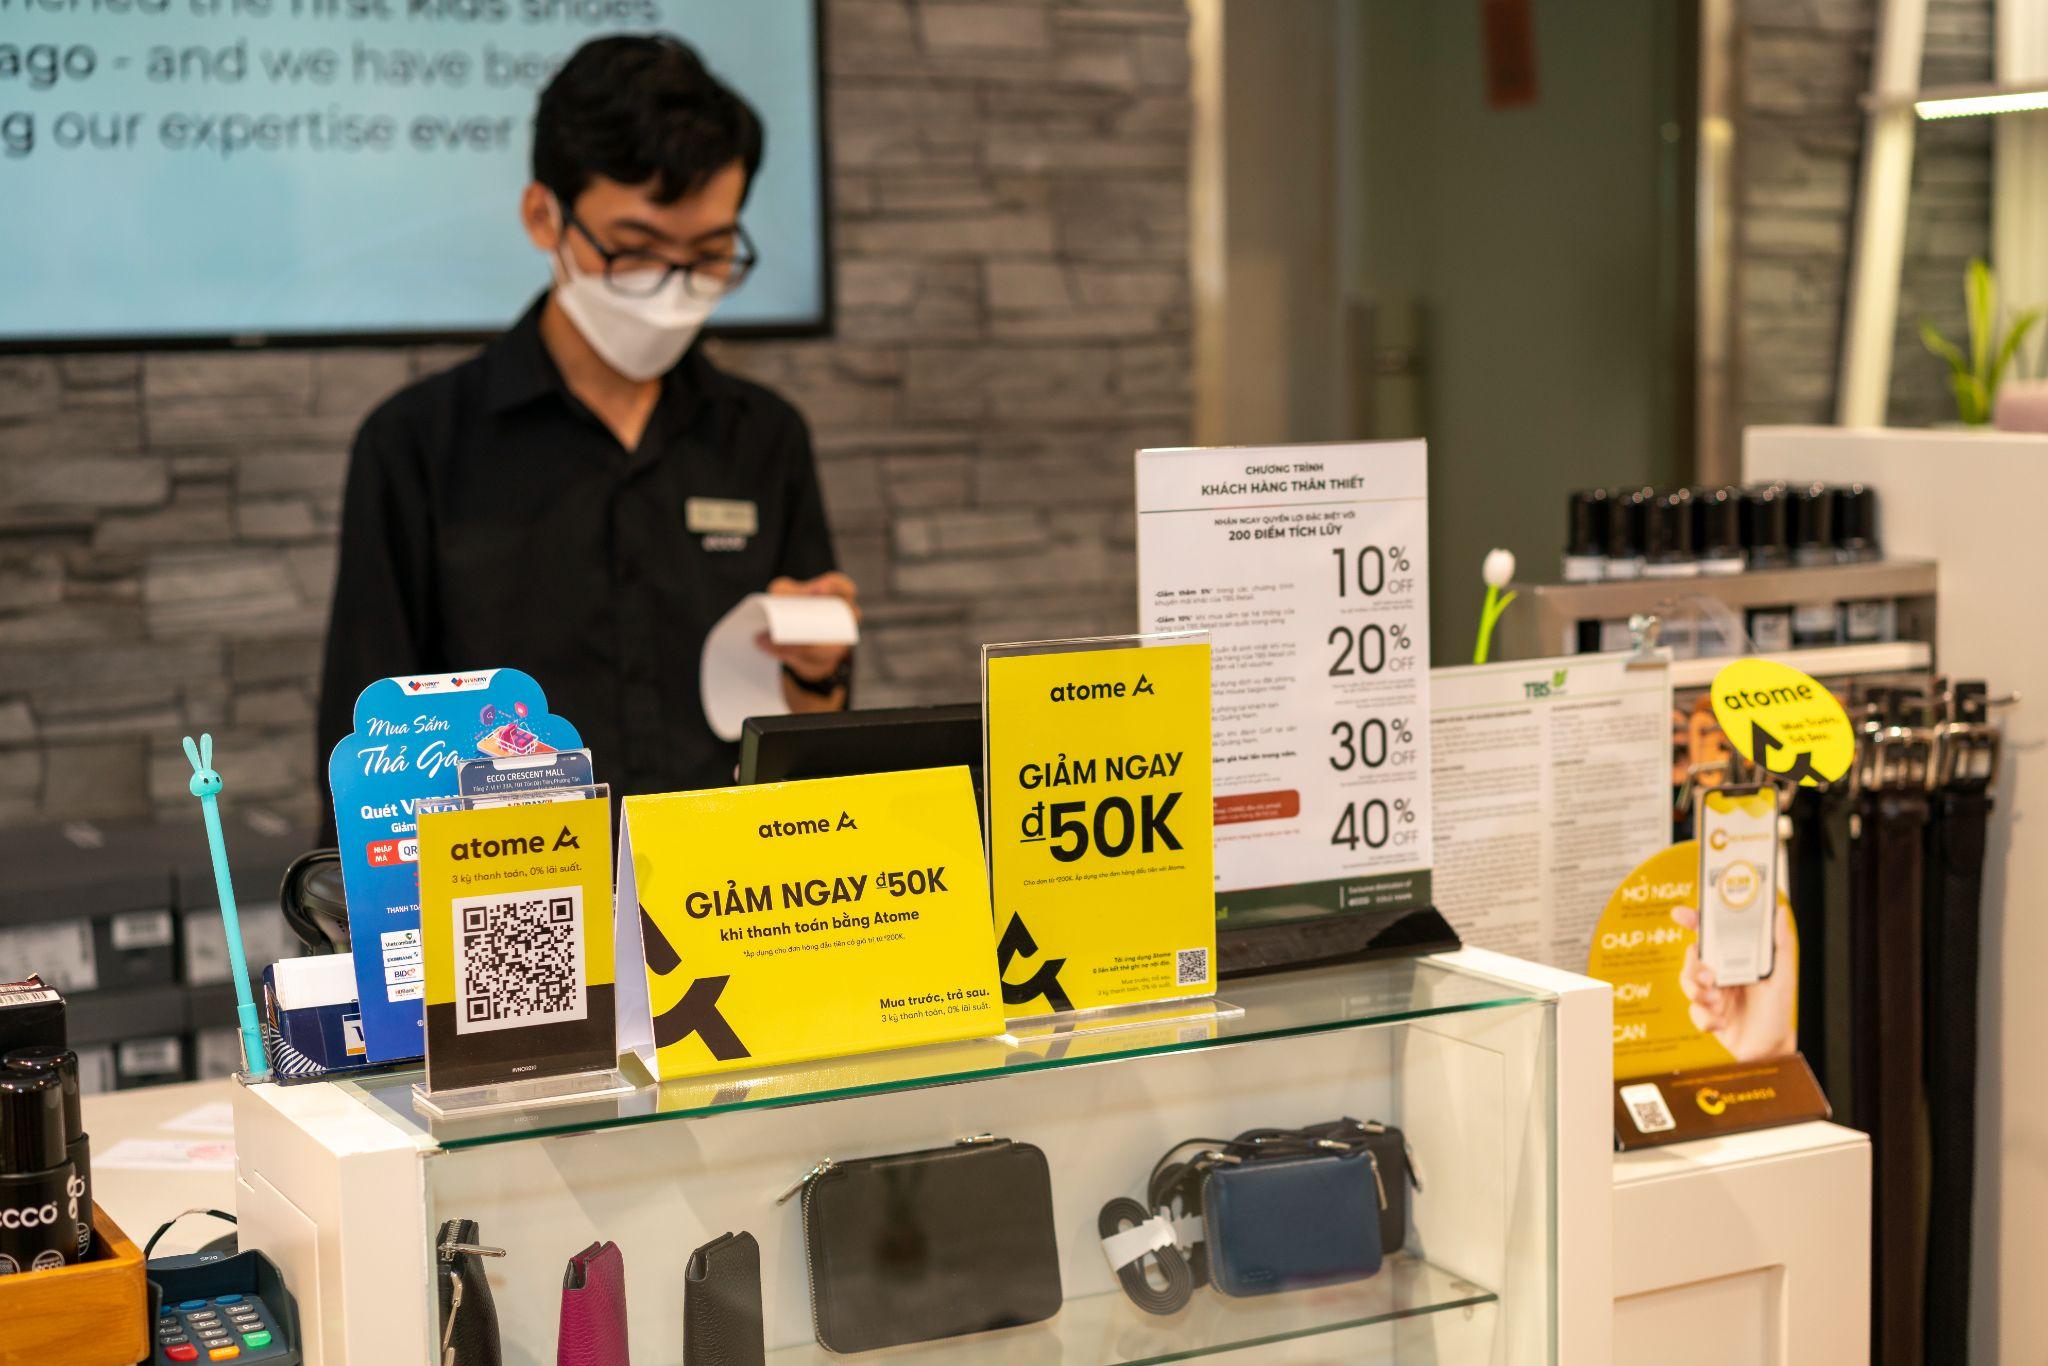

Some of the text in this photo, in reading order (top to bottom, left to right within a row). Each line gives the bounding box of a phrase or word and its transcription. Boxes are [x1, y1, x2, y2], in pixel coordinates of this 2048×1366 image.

[147, 37, 247, 84] and
[259, 47, 338, 86] we
[352, 40, 474, 88] have
[53, 111, 145, 149] our
[158, 103, 398, 160] expertise
[408, 115, 515, 152] ever
[1245, 461, 1324, 476] CHƯƠNG TRÌNH
[1201, 476, 1365, 497] KHÁCH HÀNG THÂN THIẾT
[1239, 516, 1261, 525] NGAY
[1228, 530, 1251, 541] 200
[1254, 526, 1286, 540] ĐIỂM
[1289, 524, 1317, 538] TÍCH
[1388, 578, 1414, 594] OFF
[1389, 656, 1415, 672] OFF
[1050, 681, 1126, 702] atome
[1523, 682, 1550, 699] TBS
[1724, 683, 1815, 710] atome
[366, 714, 450, 737] Mua Sắm
[357, 740, 463, 778] Thả Ga
[1391, 749, 1416, 766] OFF
[486, 768, 565, 783] ECCO CRESCENT MALL
[1019, 753, 1097, 790] GIẢM
[1105, 751, 1184, 782] NGAY
[360, 803, 399, 820] Quét
[391, 821, 417, 833] Giảm
[758, 818, 830, 839] atome
[451, 834, 545, 861] atome
[1393, 830, 1418, 847] OFF
[452, 874, 458, 883] 3
[474, 868, 502, 881] thanh
[504, 866, 528, 879] toán,
[529, 865, 544, 876] 0%
[546, 863, 558, 874] lãi
[559, 861, 582, 873] suất.
[685, 879, 773, 919] GIẢM
[782, 874, 868, 909] NGAY
[1651, 882, 1693, 900] NGAY
[386, 904, 409, 914] THANH
[720, 908, 919, 942] khi thanh toán bằng Atome
[880, 987, 990, 1010] Mua trước, trả sau.
[881, 1014, 888, 1023] 3
[900, 1009, 923, 1020] thanh
[924, 1006, 946, 1018] toán,
[947, 1005, 960, 1015] 0%
